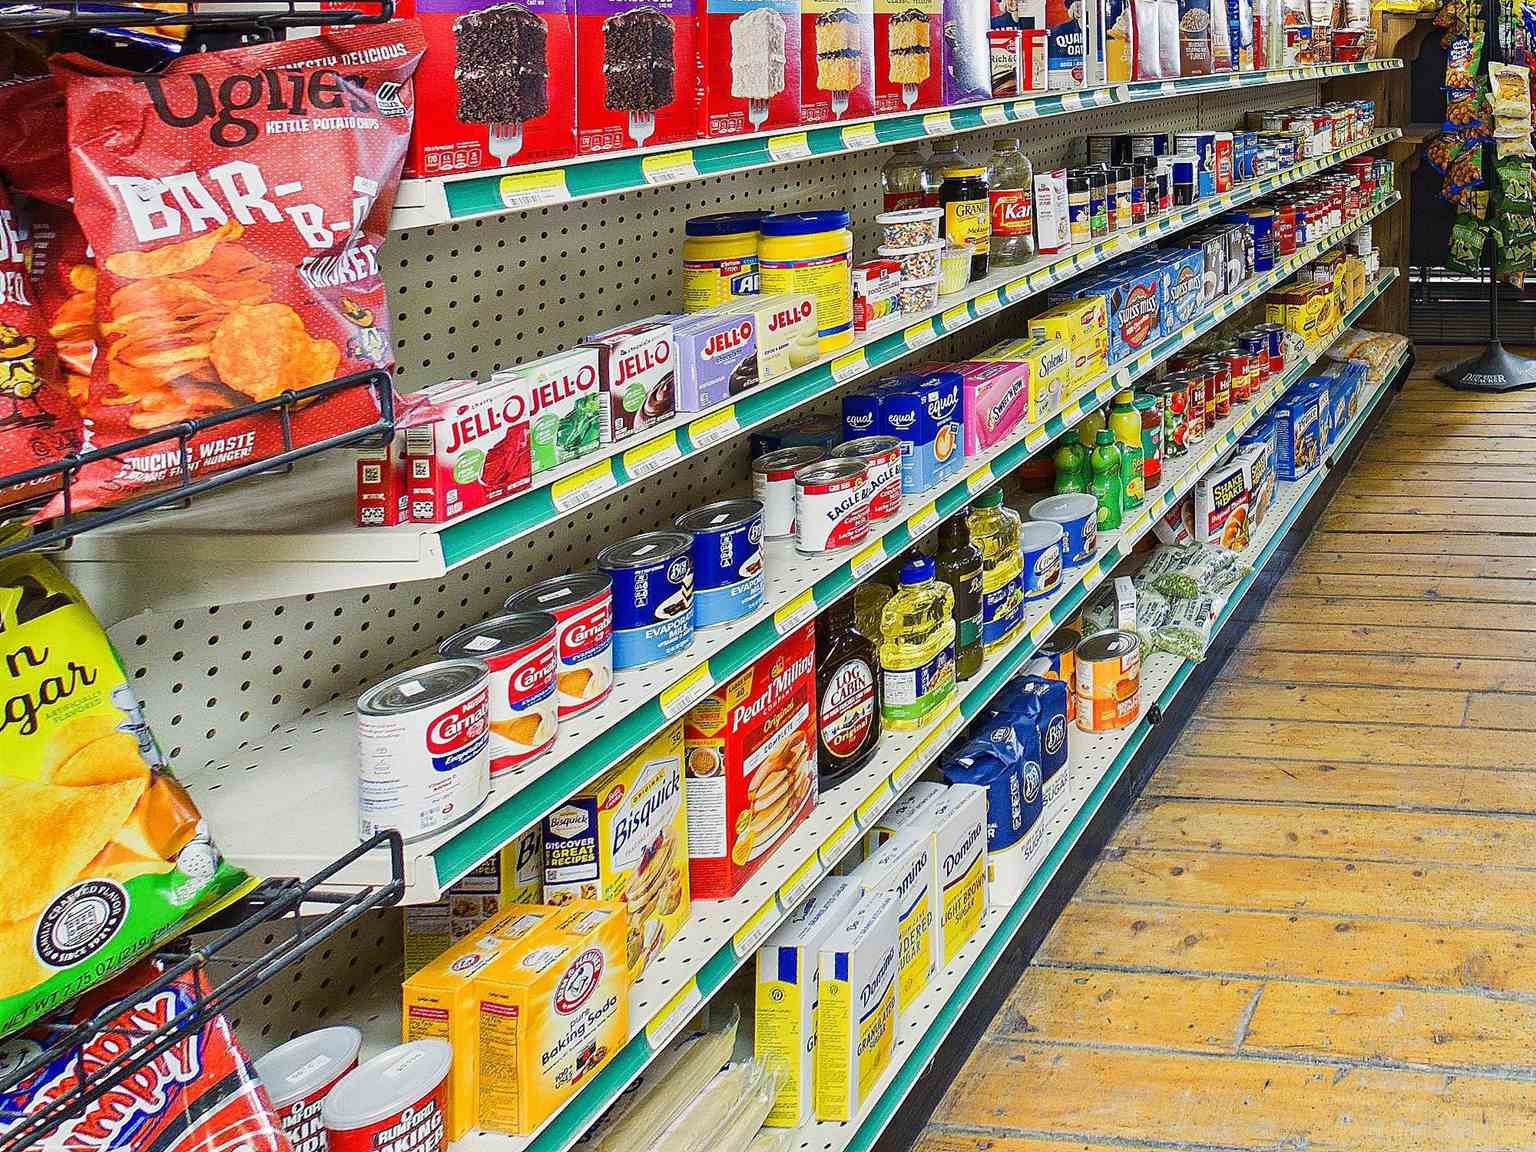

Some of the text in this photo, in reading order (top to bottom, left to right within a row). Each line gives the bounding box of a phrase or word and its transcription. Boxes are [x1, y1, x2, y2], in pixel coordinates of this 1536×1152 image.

[1056, 33, 1084, 47] QUAK
[266, 119, 356, 134] KETTLE POTATO
[107, 160, 303, 242] BAR-
[928, 386, 959, 414] equal
[846, 412, 872, 423] equal
[888, 411, 915, 422] equal
[200, 431, 256, 458] WASTE
[869, 468, 896, 493] AGLE
[1214, 473, 1244, 499] SHAKE
[1222, 482, 1244, 505] BAKE
[827, 492, 860, 521] EAGLE
[831, 675, 867, 706] CABIN
[835, 665, 860, 688] LOG
[0, 665, 99, 735] gar
[732, 649, 815, 733] Pearl Milling
[764, 698, 794, 732] Original
[834, 716, 868, 746] Original
[551, 816, 588, 828] Bisquick
[612, 769, 680, 856] Bisquick
[545, 838, 594, 850] DISCOVER
[552, 846, 594, 859] GREAT
[942, 823, 983, 877] Domino
[551, 854, 595, 866] RECIPES
[899, 851, 929, 900] omino
[860, 945, 895, 1004] Domino
[542, 996, 617, 1066] Baking Soda
[378, 1102, 434, 1144] RUMFORD
